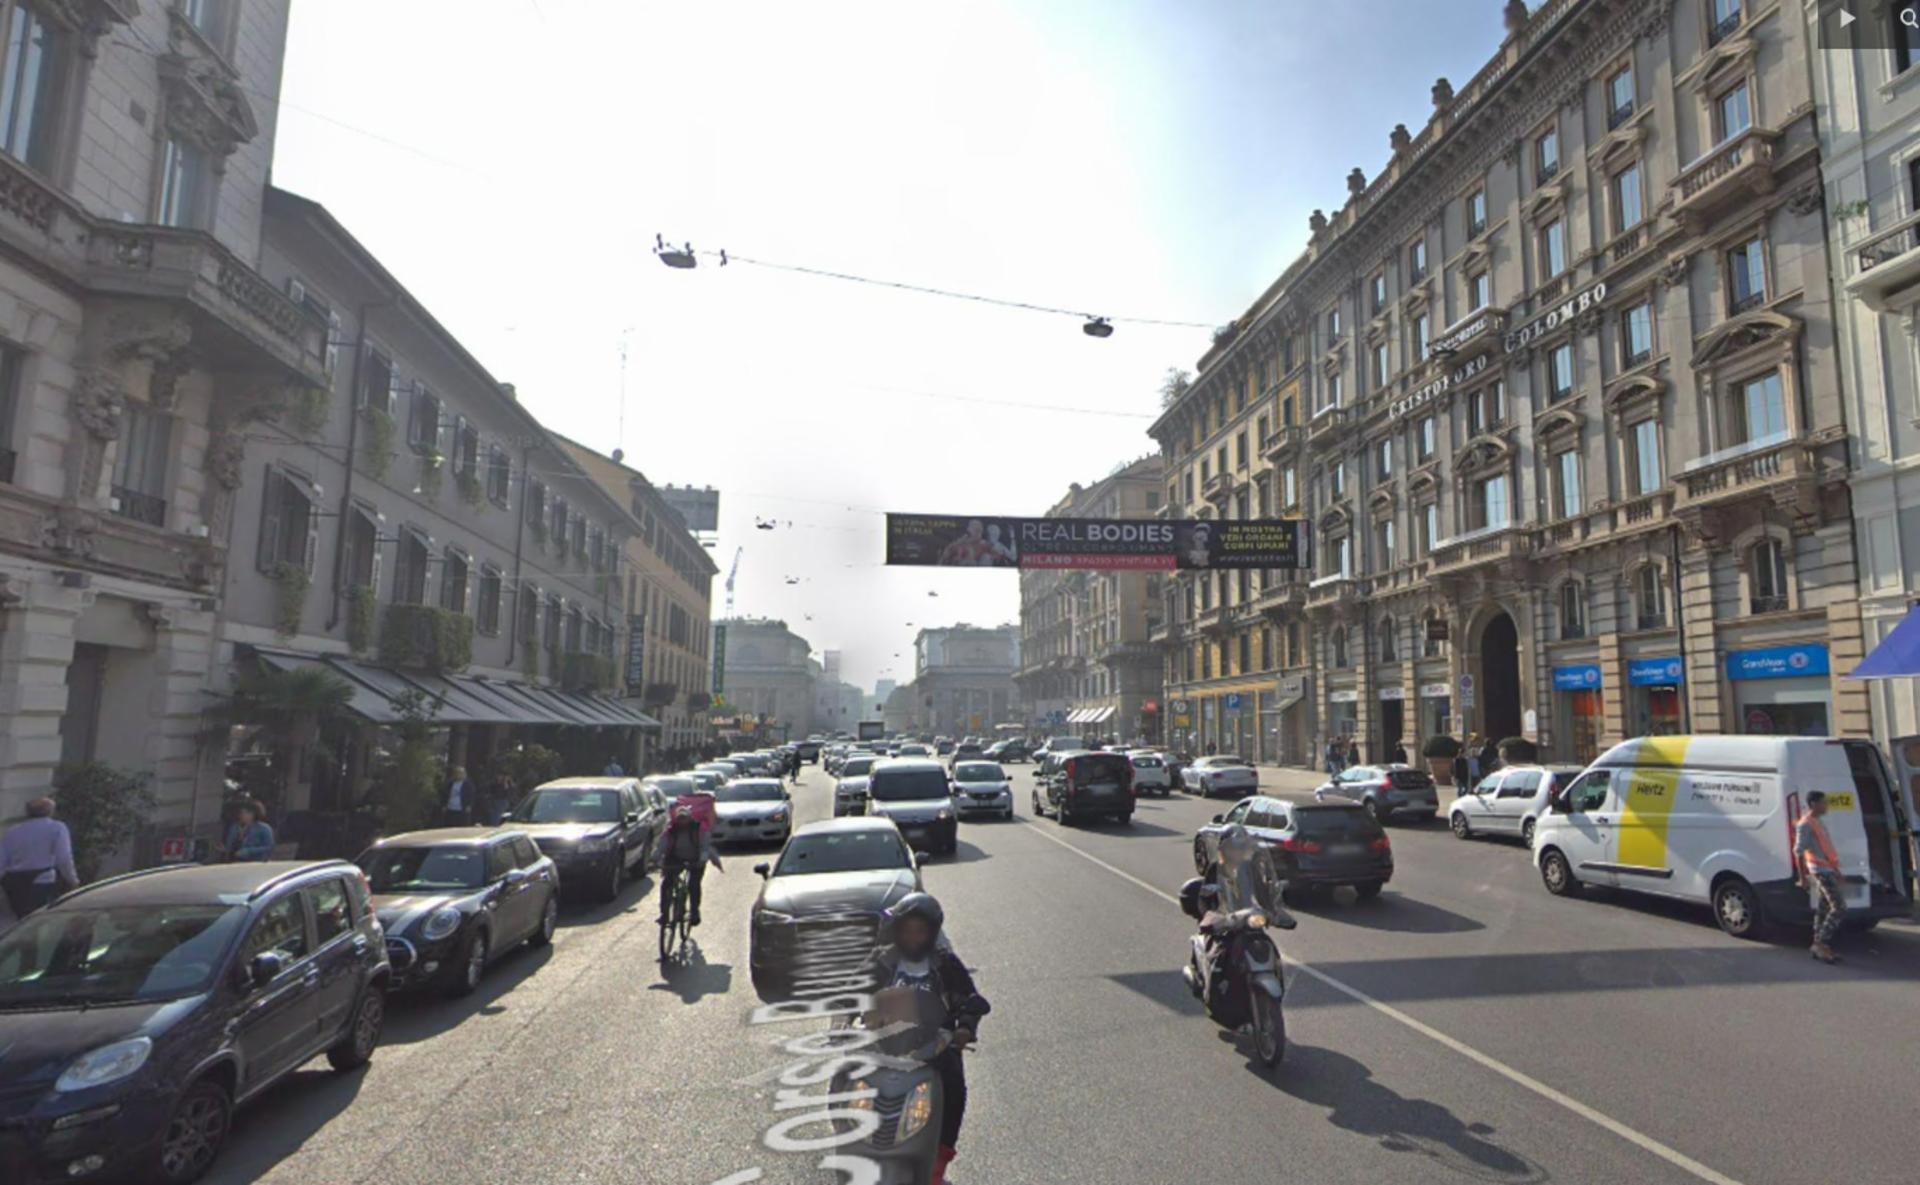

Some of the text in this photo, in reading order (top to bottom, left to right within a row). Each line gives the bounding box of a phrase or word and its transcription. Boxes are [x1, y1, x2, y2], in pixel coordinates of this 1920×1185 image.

[1504, 282, 1606, 353] COLOMBO
[1022, 522, 1174, 542] REAL BODIES
[1022, 555, 1072, 564] MILANO
[1637, 783, 1665, 796] Hertz
